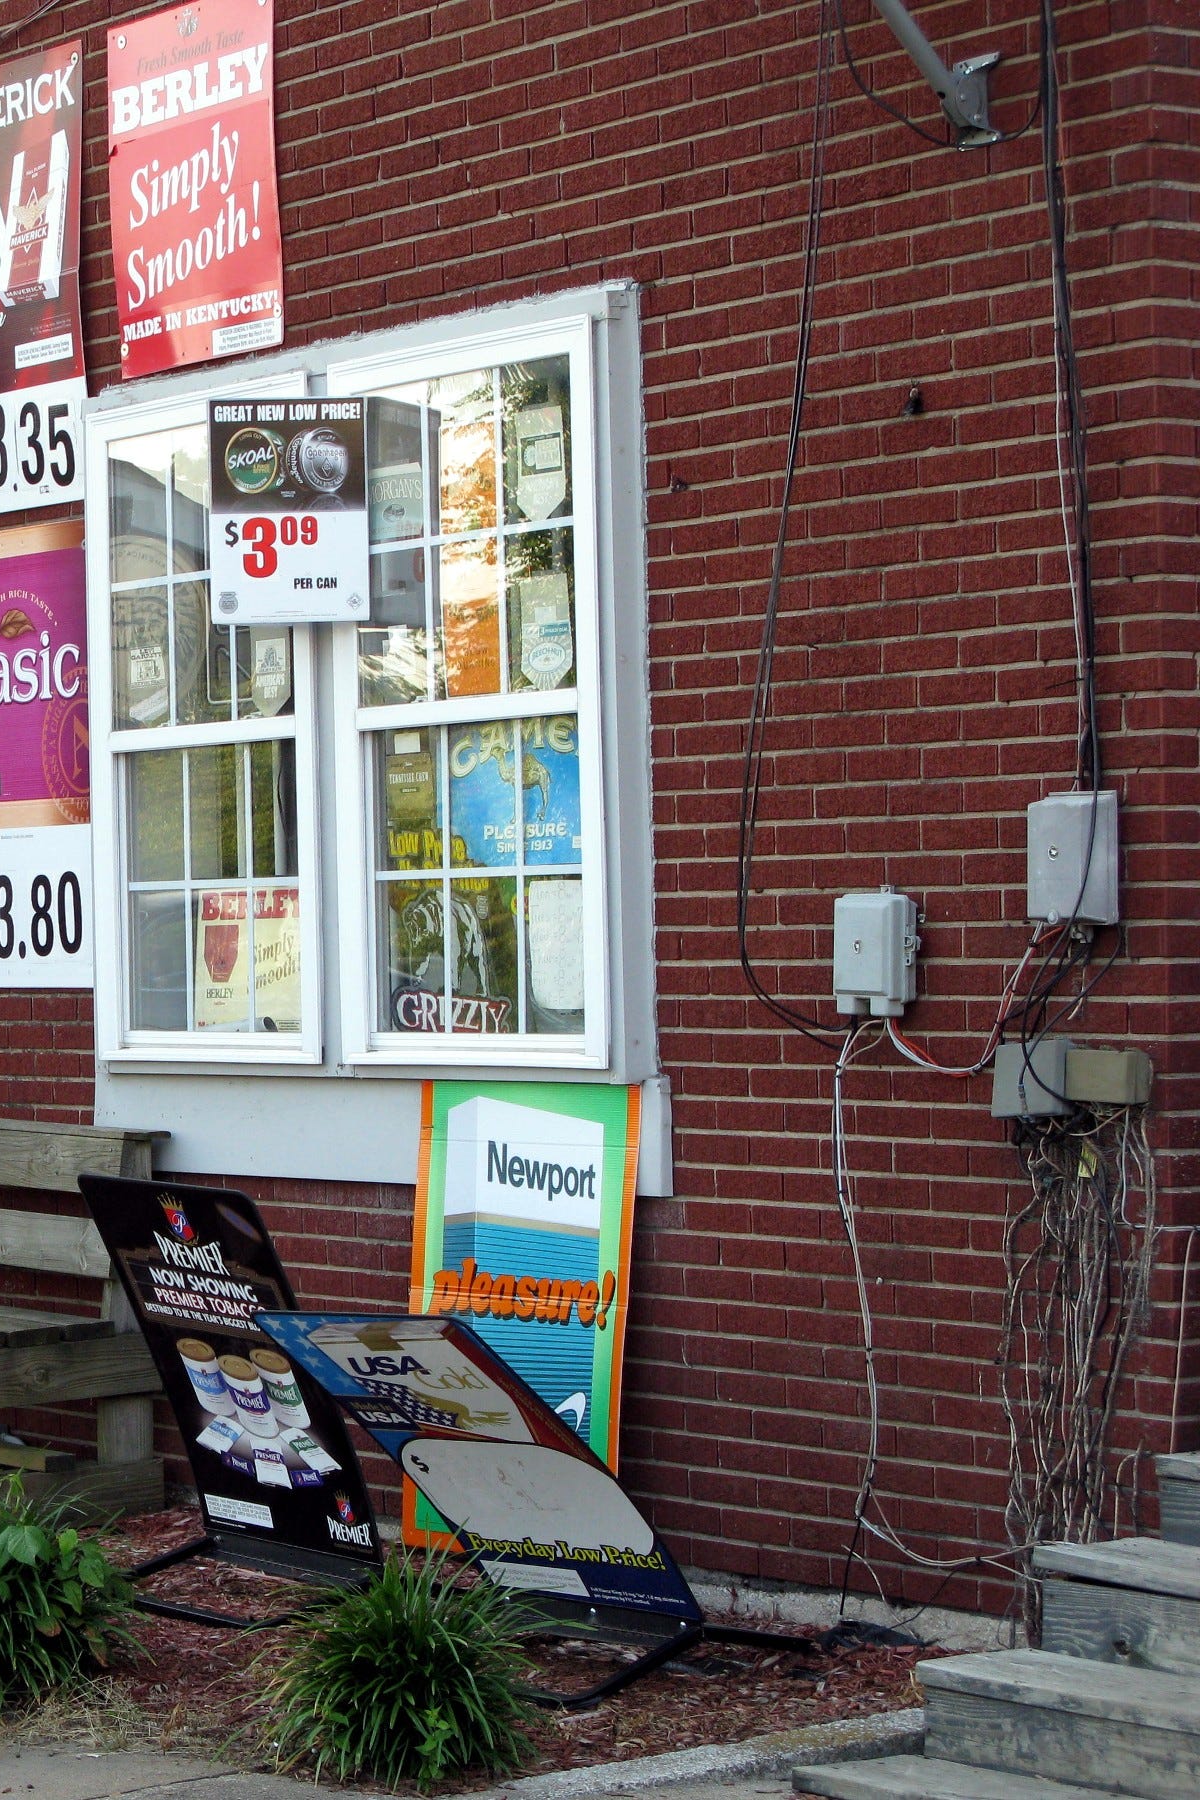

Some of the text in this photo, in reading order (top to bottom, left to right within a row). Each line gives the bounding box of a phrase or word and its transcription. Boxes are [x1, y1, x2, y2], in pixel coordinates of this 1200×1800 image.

[112, 43, 268, 135] BERLEY
[129, 121, 239, 230] Simply
[11, 226, 48, 247] MAVERICK
[127, 181, 260, 311] Smooth!
[6, 284, 44, 297] MAVERICK
[123, 289, 279, 343] MADE IN KENTUCKY!
[214, 402, 361, 422] GREAT NEW LOW PRICE!
[228, 446, 274, 469] SKOAL
[294, 577, 338, 590] PER CAN
[8, 589, 28, 600] RICH
[30, 592, 55, 620] TASTE
[451, 714, 579, 778] CAME
[483, 822, 567, 841] PLESURE
[531, 840, 553, 852] 1913
[247, 951, 300, 994] mooth!
[206, 988, 234, 999] BERLEY
[396, 991, 506, 1033] GRIZZLY
[487, 1140, 596, 1201] Newport
[153, 1230, 230, 1277] PREMIER
[148, 1266, 258, 1303] NOW SHOWING
[427, 1257, 616, 1330] pleasure!
[145, 1302, 247, 1330] DESTINED TO BE THE YEAR'S BIGGEST
[153, 1287, 266, 1319] PREMIER TOBAC
[347, 1355, 489, 1390] USA Gold
[234, 1390, 266, 1410] PREMIER
[271, 1386, 297, 1401] PREMIER
[356, 1411, 411, 1424] USA
[255, 1453, 282, 1461] PREMIER
[326, 1515, 373, 1547] PREMIER
[467, 1532, 667, 1571] Everyday Low Price!
